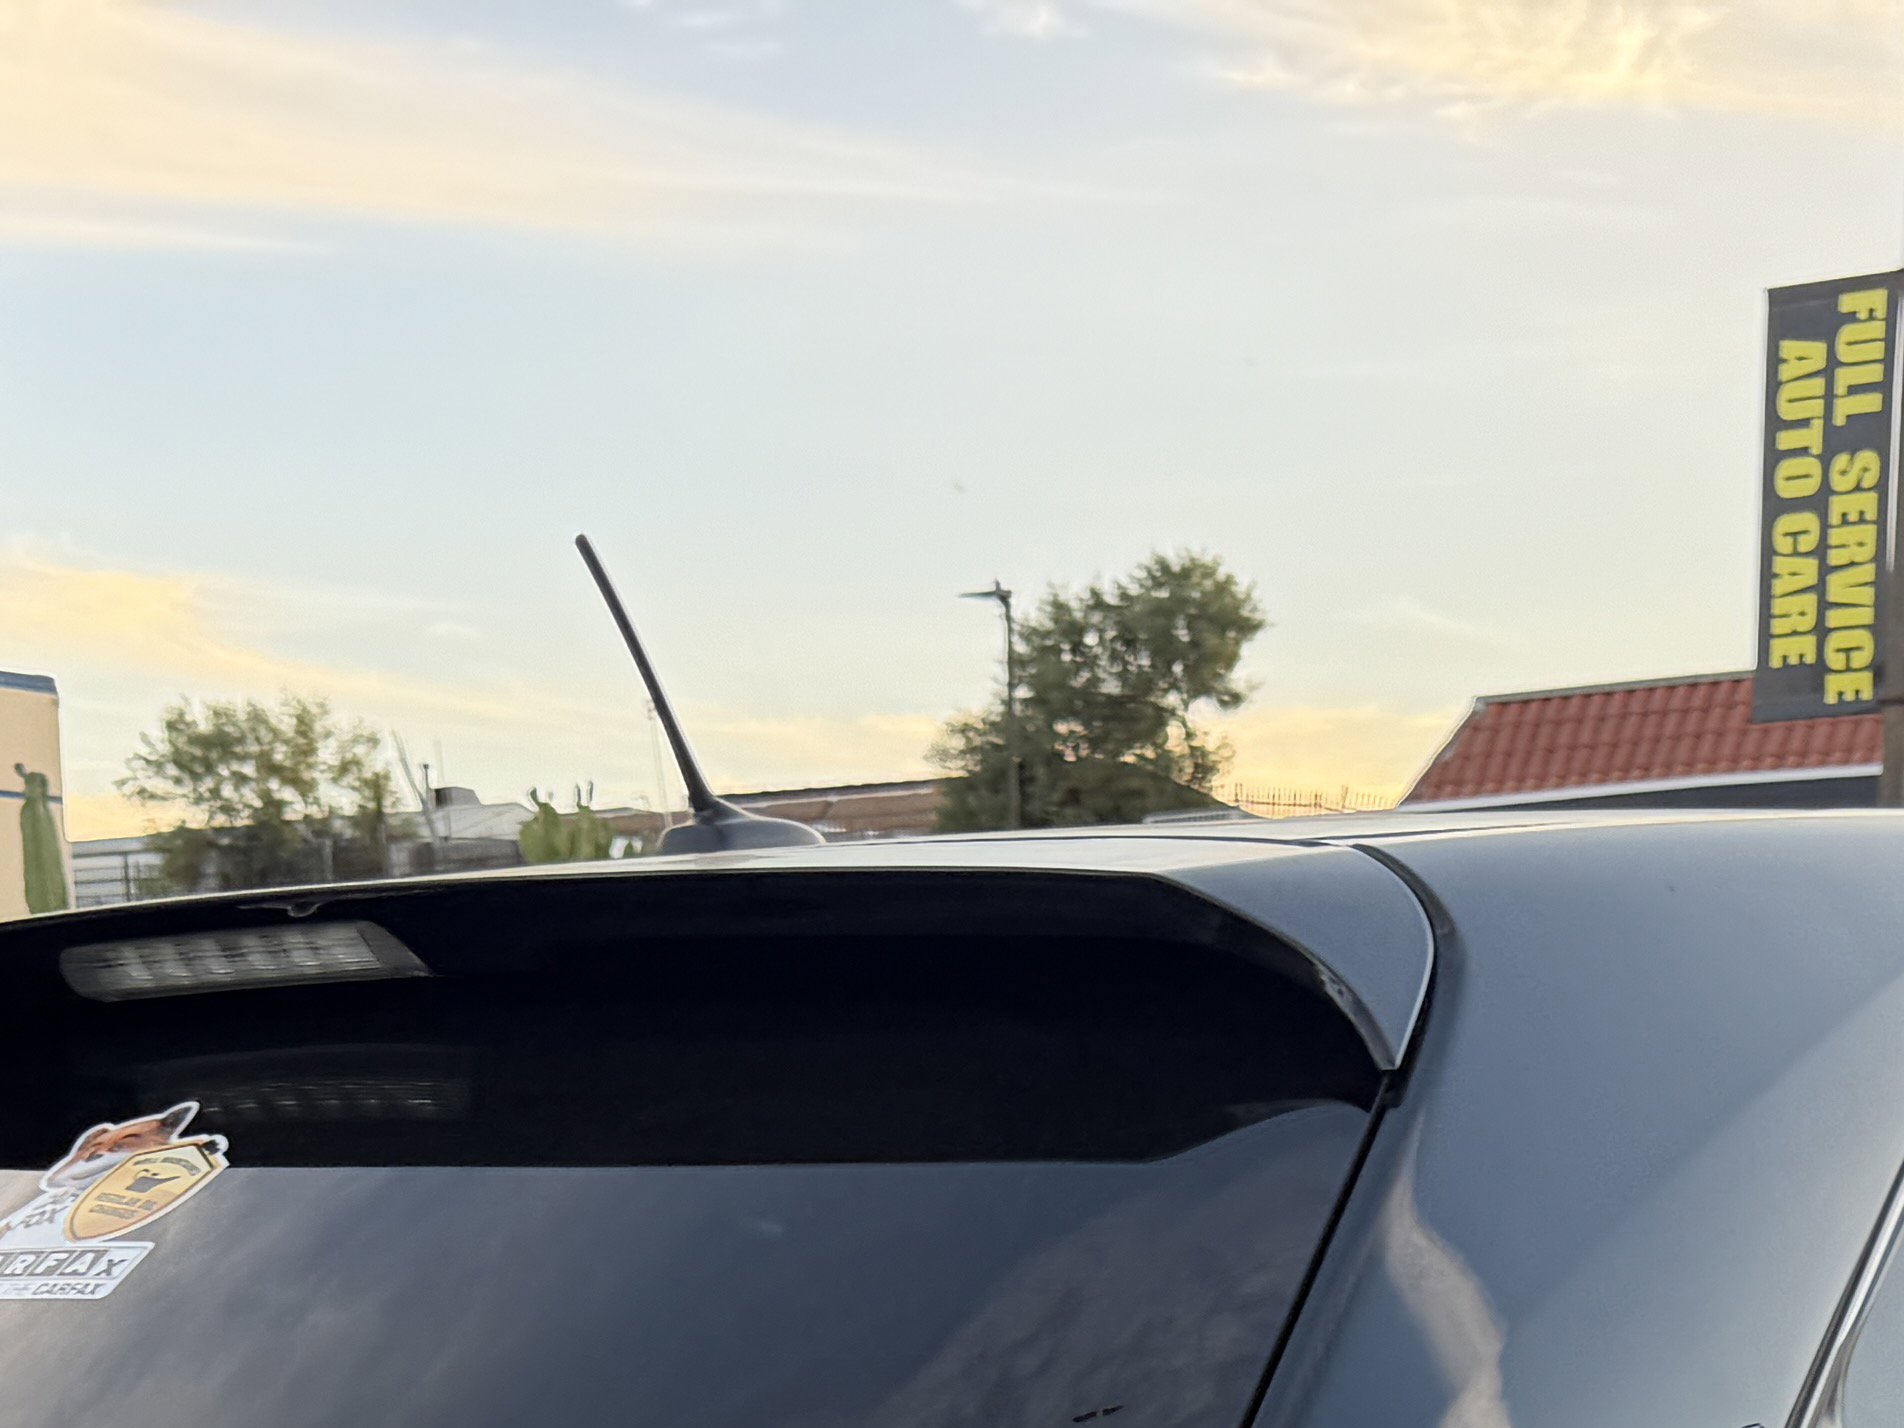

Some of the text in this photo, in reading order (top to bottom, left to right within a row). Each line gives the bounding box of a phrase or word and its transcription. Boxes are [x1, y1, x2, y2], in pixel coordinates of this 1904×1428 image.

[1769, 339, 1827, 668] AUTO CARE
[1823, 288, 1888, 705] FULL SERVICE
